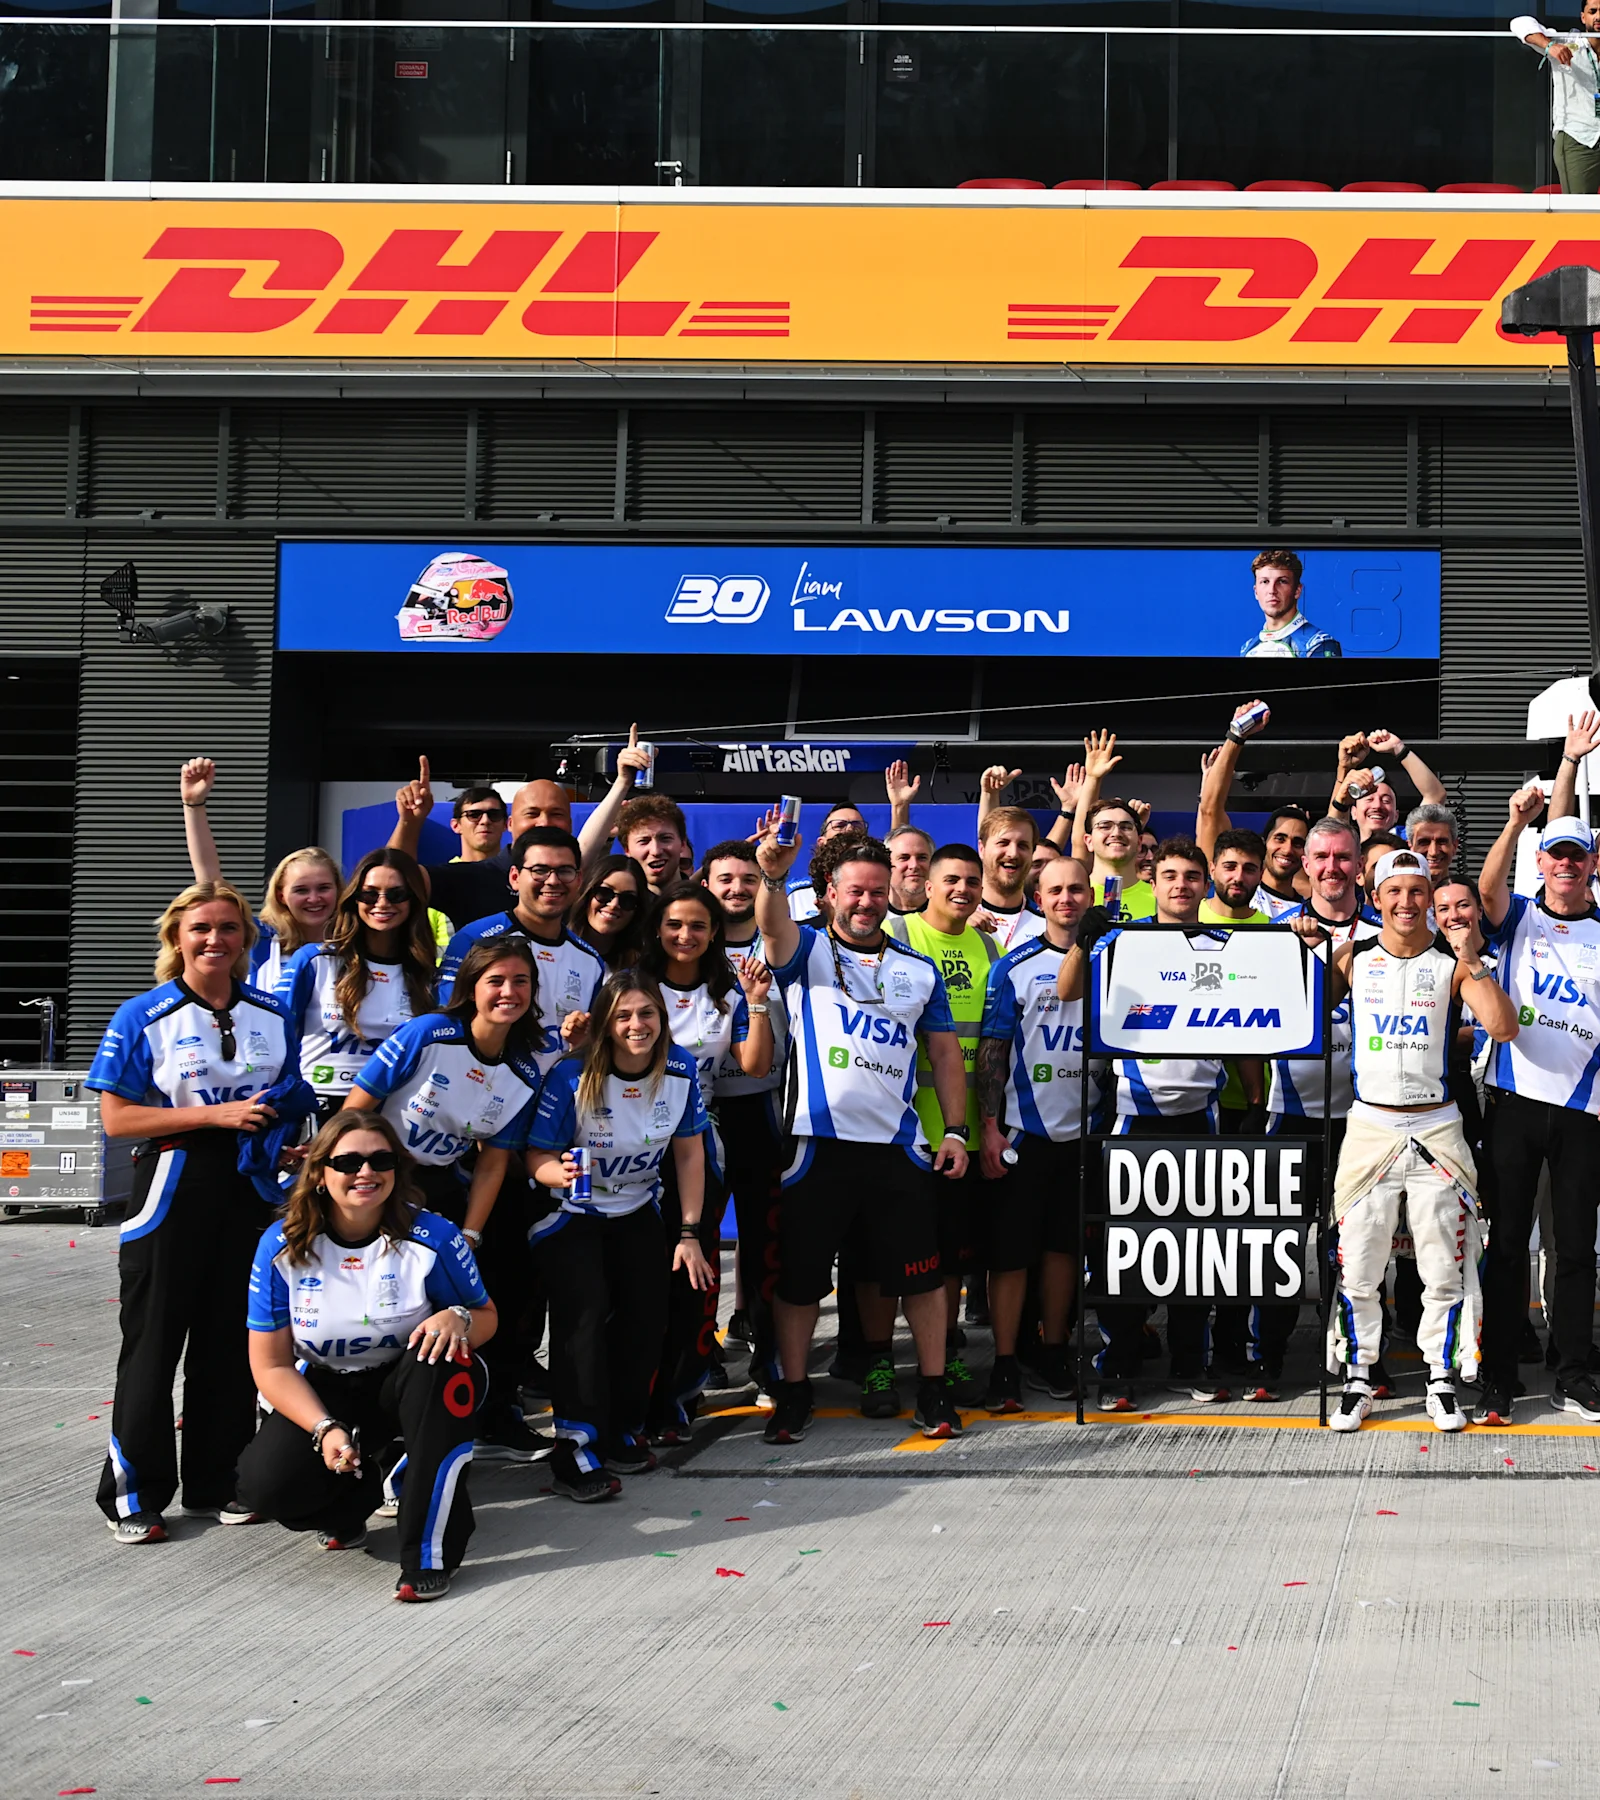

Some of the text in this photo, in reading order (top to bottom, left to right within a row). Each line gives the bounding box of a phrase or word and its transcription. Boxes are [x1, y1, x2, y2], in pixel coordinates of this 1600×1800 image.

[132, 228, 689, 336] DHL
[790, 561, 843, 606] Liam
[664, 574, 770, 624] 30
[447, 603, 507, 625] Red Bull
[793, 608, 1069, 633] LAWSON
[722, 744, 851, 774] Airtasker
[480, 924, 504, 938] HUGO
[1209, 930, 1229, 940] HUG
[941, 950, 963, 959] VISA
[1009, 947, 1034, 963] HUGO
[1531, 949, 1549, 959] Mobil
[1159, 971, 1187, 981] VISA
[146, 997, 174, 1017] HUGO
[1364, 996, 1384, 1004] Mobil
[1411, 1000, 1436, 1008] HUGO
[323, 1012, 344, 1020] Mob
[1186, 1008, 1281, 1028] LIAM
[1370, 1013, 1429, 1036] VISA
[432, 1027, 455, 1038] HUGO
[833, 1003, 908, 1048] VISA
[1538, 1014, 1593, 1040] Cash App
[1036, 1025, 1084, 1051] VIS
[1386, 1041, 1429, 1052] Cash App
[178, 1059, 207, 1069] TUDOR
[665, 1060, 686, 1070] UGO
[854, 1056, 903, 1080] Cash App
[180, 1068, 208, 1080] Mobil
[191, 1082, 270, 1105] VIS
[417, 1093, 440, 1108] TUDOR
[409, 1101, 435, 1118] Mobil
[588, 1140, 613, 1148] Mobil
[1108, 1149, 1302, 1216] DOUBLE
[904, 1252, 941, 1277] HUG
[1107, 1227, 1301, 1297] POINTS
[293, 1317, 318, 1328] Mobil
[299, 1334, 402, 1357] VISA
